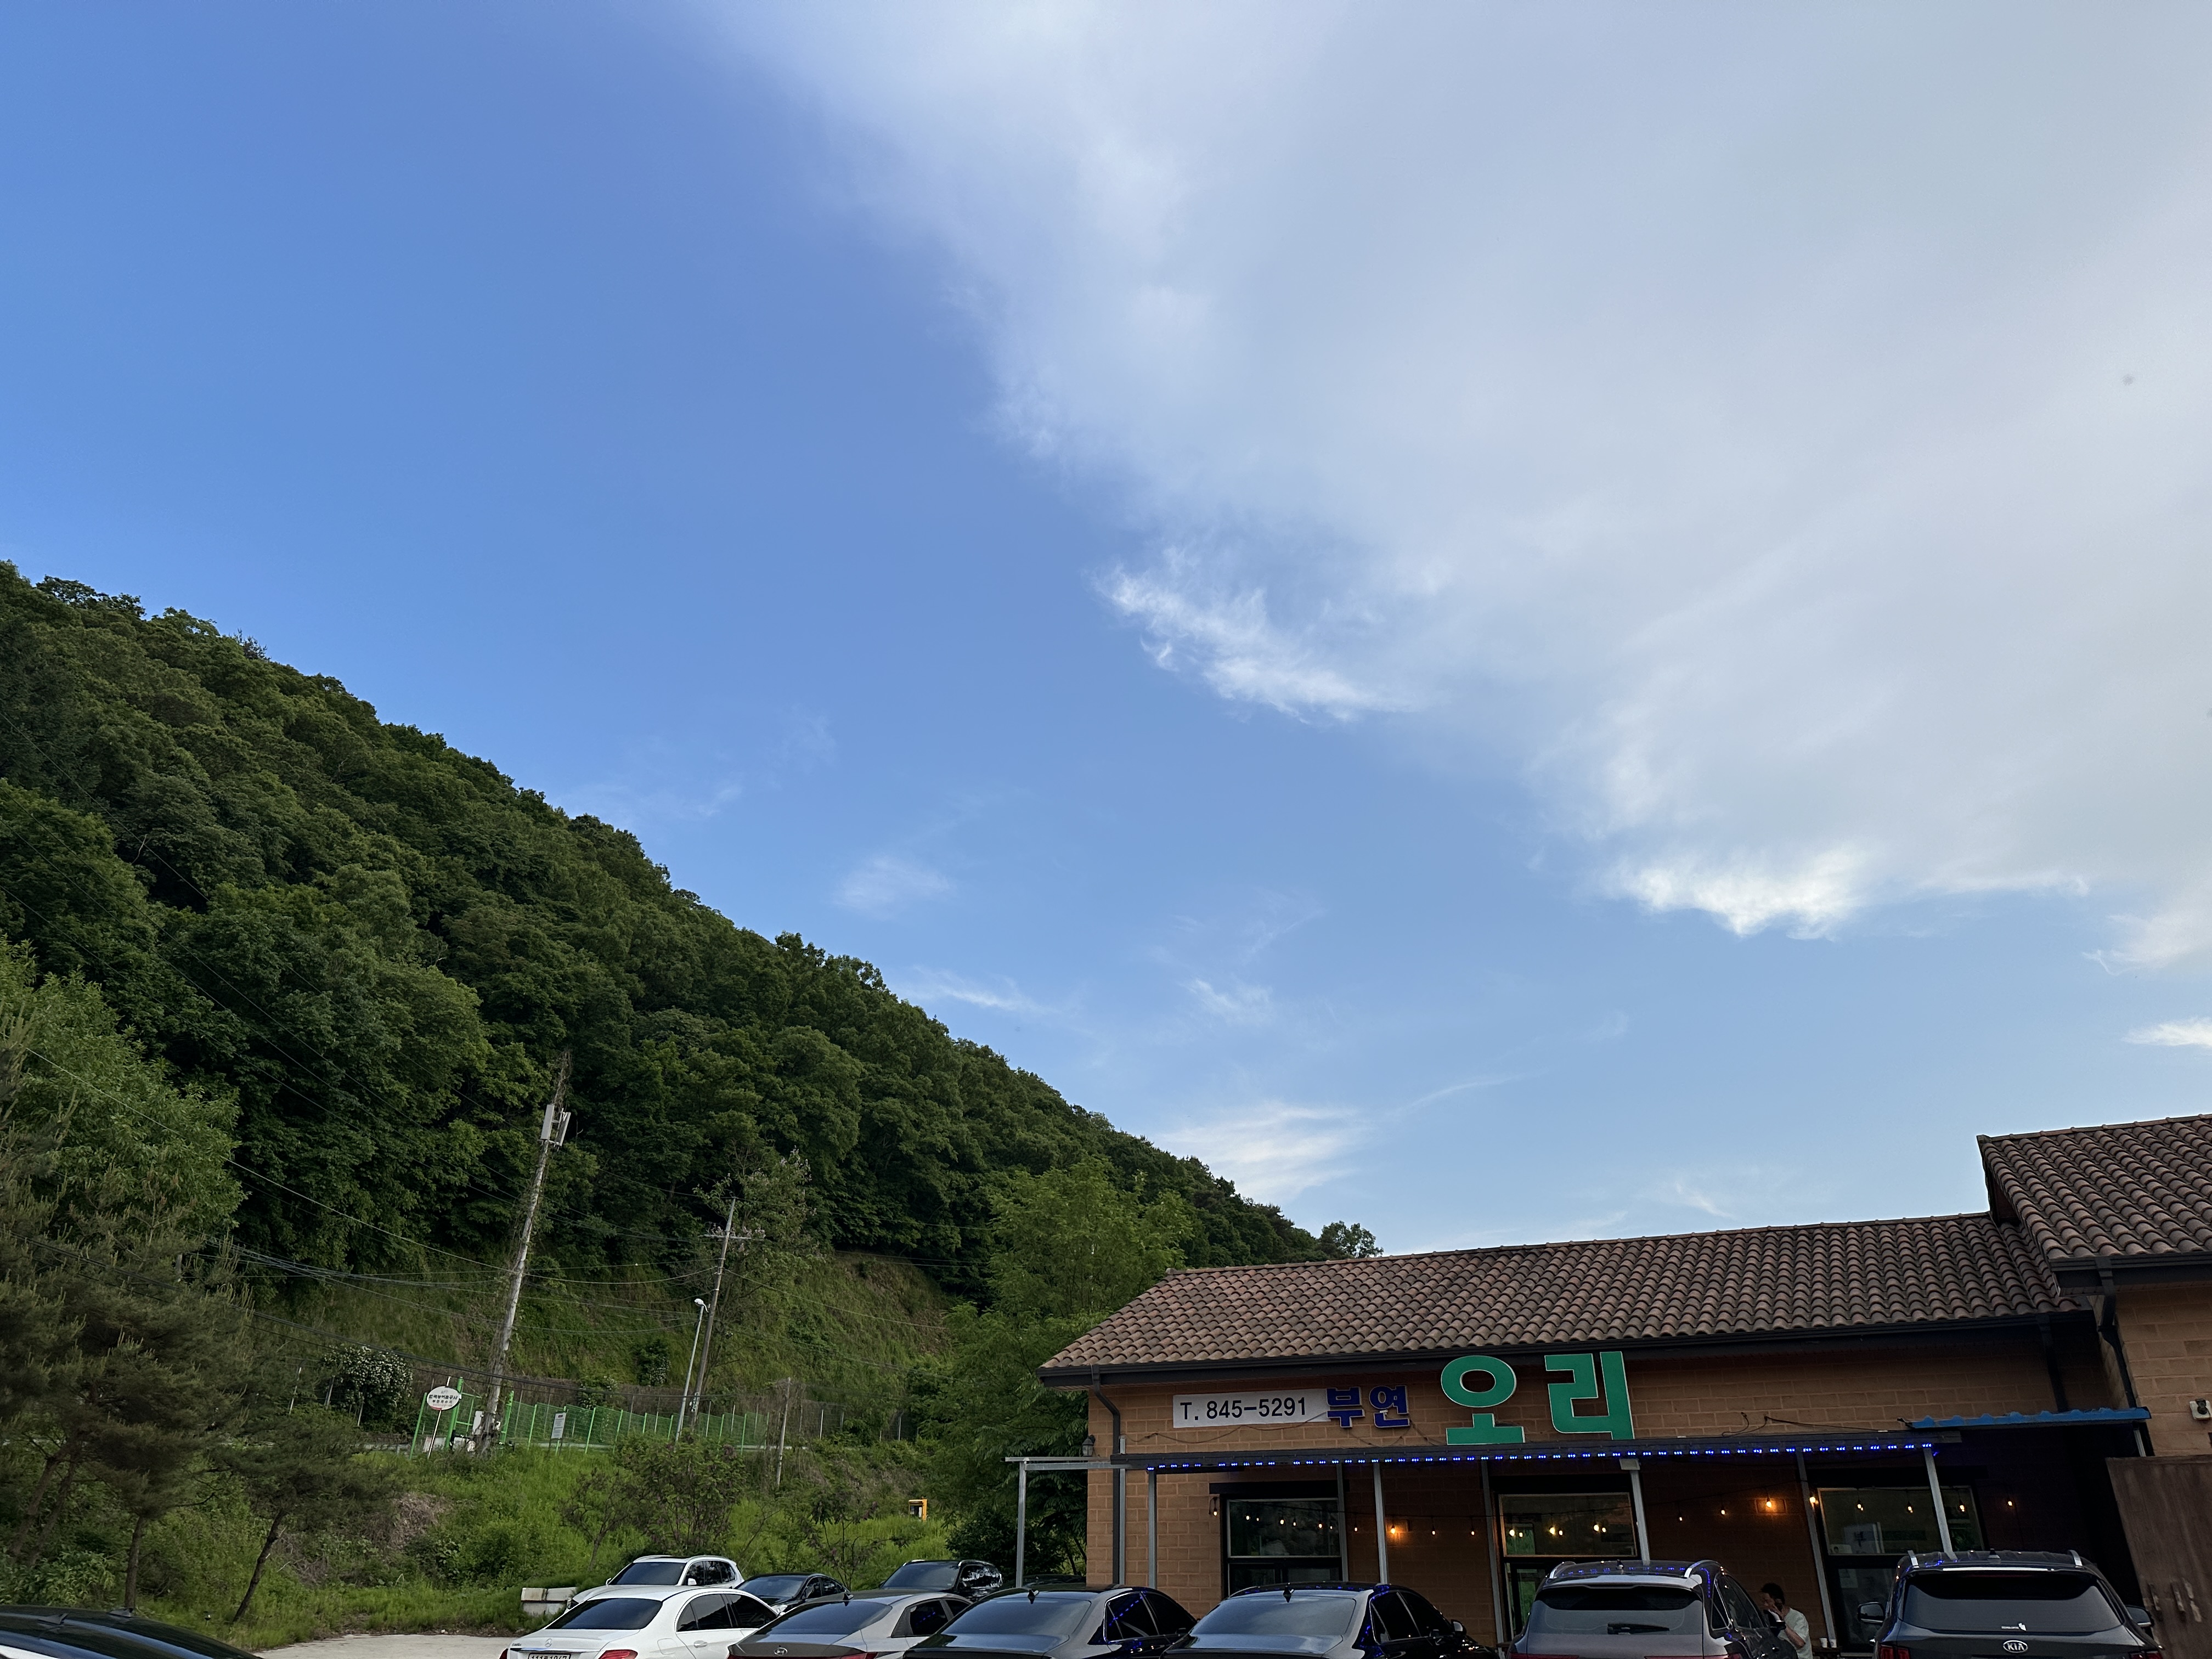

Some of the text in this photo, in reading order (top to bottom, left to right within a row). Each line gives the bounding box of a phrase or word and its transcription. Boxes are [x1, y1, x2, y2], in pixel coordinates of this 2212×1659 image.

[1180, 1397, 1306, 1421] T. 845-5291
[1325, 1351, 1635, 1446] 부연 오리
[2006, 1643, 2025, 1651] KIA
